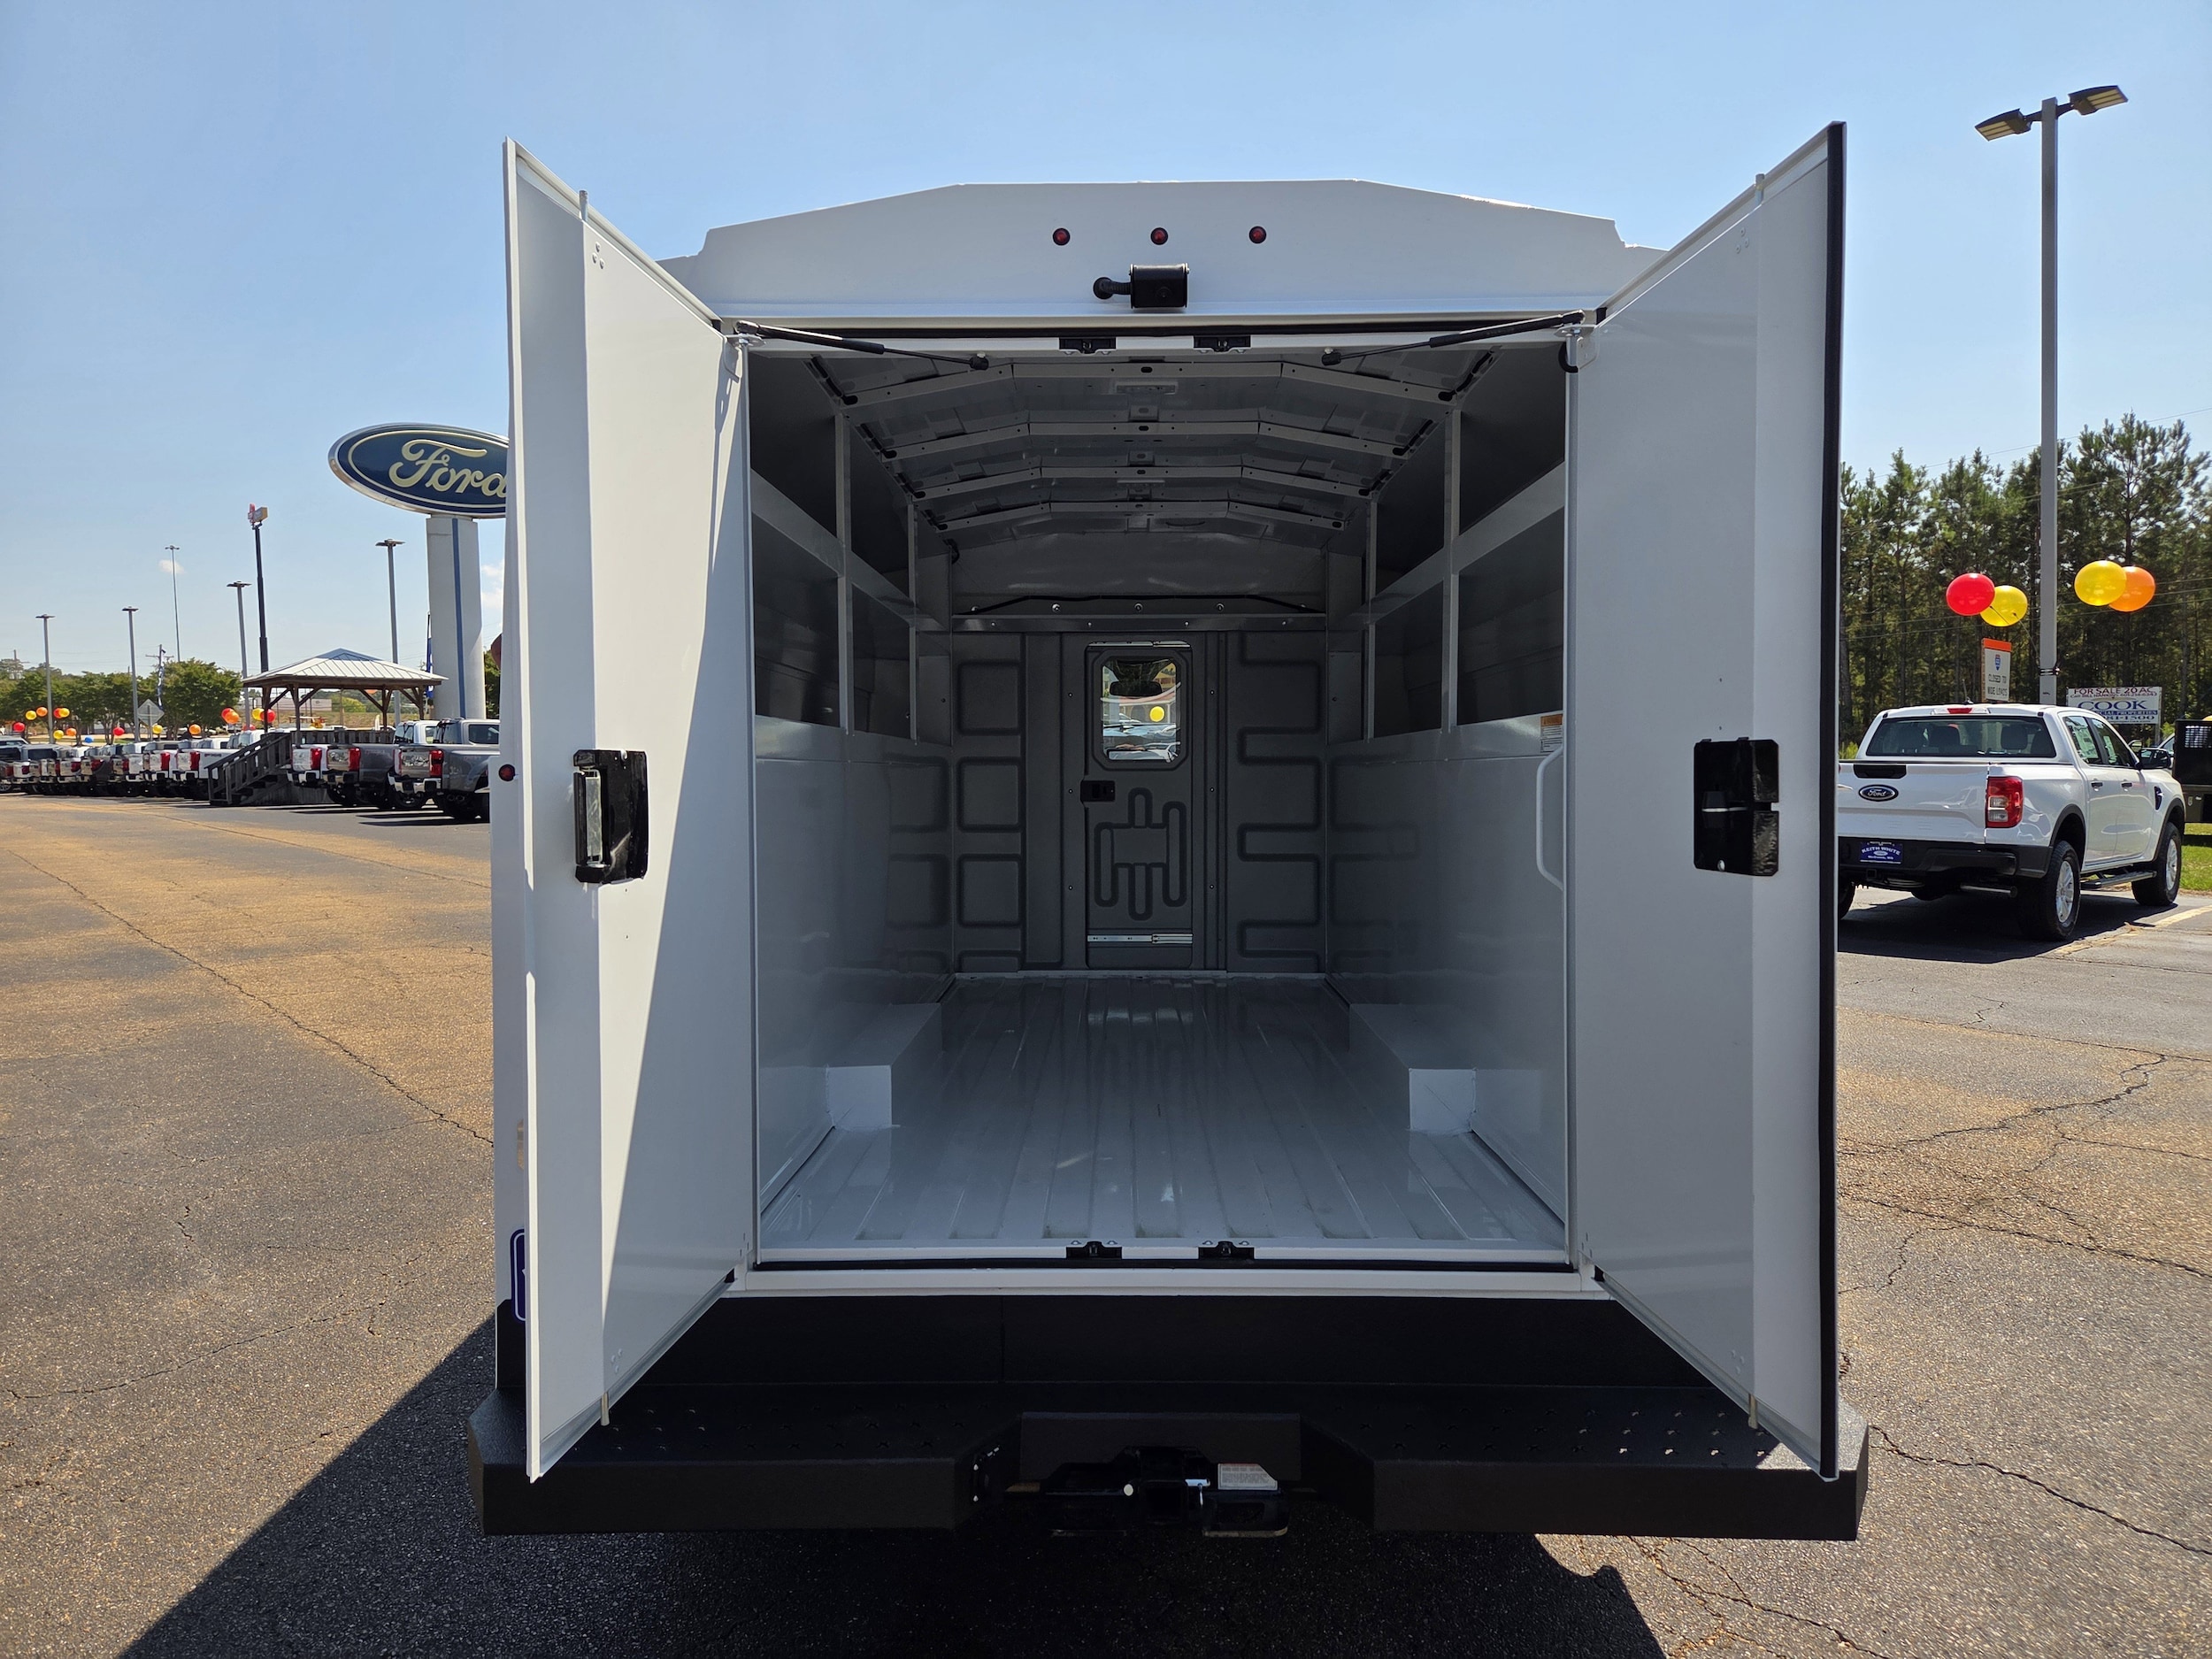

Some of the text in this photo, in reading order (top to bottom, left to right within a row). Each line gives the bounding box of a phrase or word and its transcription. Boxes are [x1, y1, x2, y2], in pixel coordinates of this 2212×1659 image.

[2078, 700, 2147, 710] COOK
[1867, 788, 1886, 797] Ford
[1881, 846, 1901, 856] WHITE
